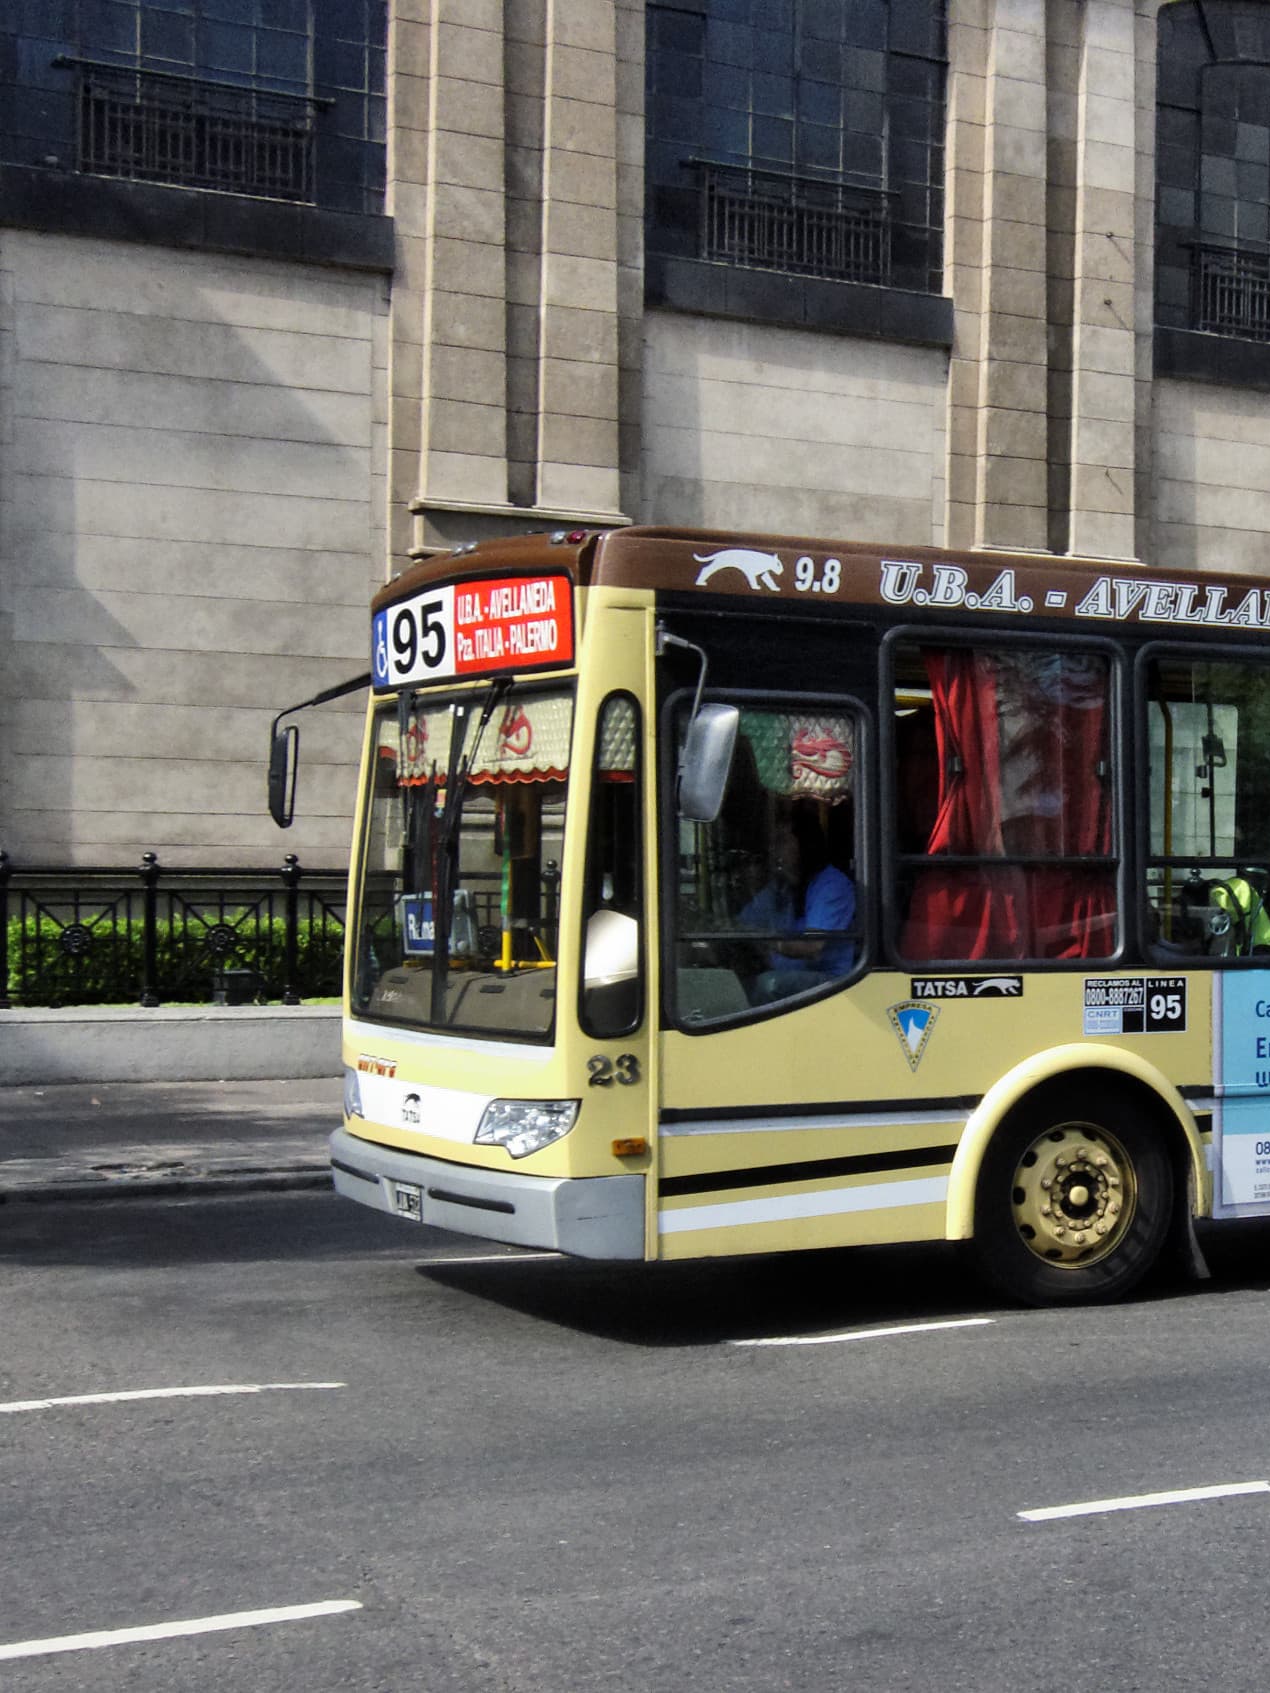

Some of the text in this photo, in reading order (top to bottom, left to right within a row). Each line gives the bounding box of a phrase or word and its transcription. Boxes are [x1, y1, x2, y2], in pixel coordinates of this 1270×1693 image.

[794, 556, 842, 594] 9.8
[880, 560, 1034, 614] U.B.A.
[457, 591, 483, 625] U.B.A.
[489, 580, 556, 619] AVELLANEDA
[393, 600, 446, 674] 95
[475, 627, 504, 660] ITALIA
[510, 619, 557, 655] PALERMO
[914, 981, 969, 997] TATSA
[1148, 980, 1184, 988] LINEA
[1087, 1010, 1118, 1018] CNRT
[1150, 994, 1182, 1019] 95
[587, 1053, 641, 1088] 23
